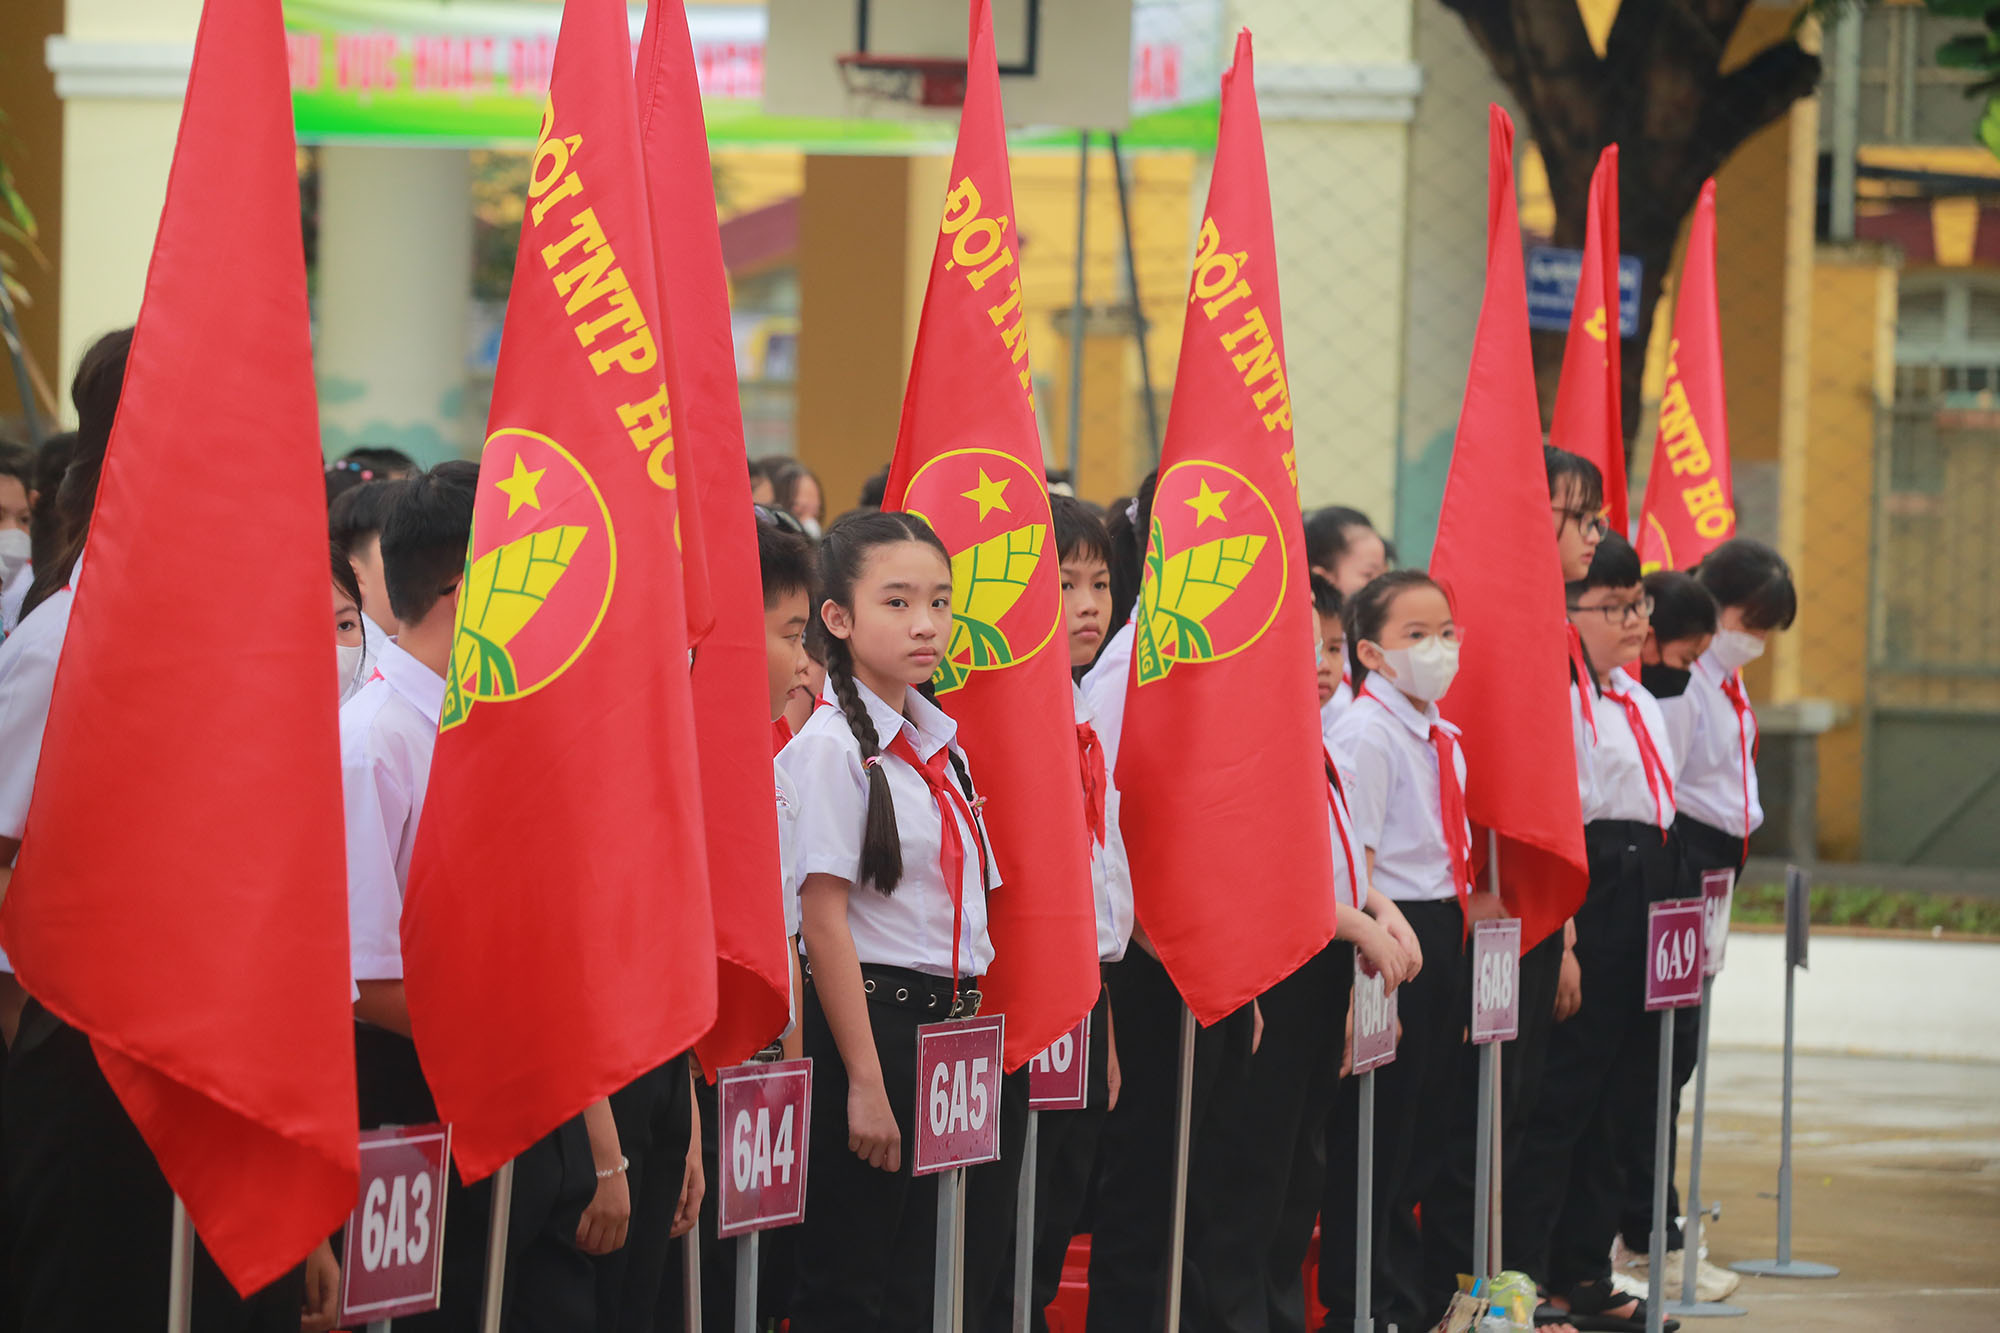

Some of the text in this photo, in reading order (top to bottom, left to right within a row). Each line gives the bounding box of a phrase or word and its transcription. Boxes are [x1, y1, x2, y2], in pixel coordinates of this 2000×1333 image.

[942, 176, 1013, 291] ĐỘI
[540, 206, 658, 377] TNTP
[1221, 305, 1293, 432] TNTP
[1481, 951, 1513, 1011] 6A8
[1656, 928, 1697, 983] 6A9
[929, 1057, 988, 1137] 6A5
[732, 1104, 795, 1192] 6A4
[361, 1171, 431, 1272] 6A3
